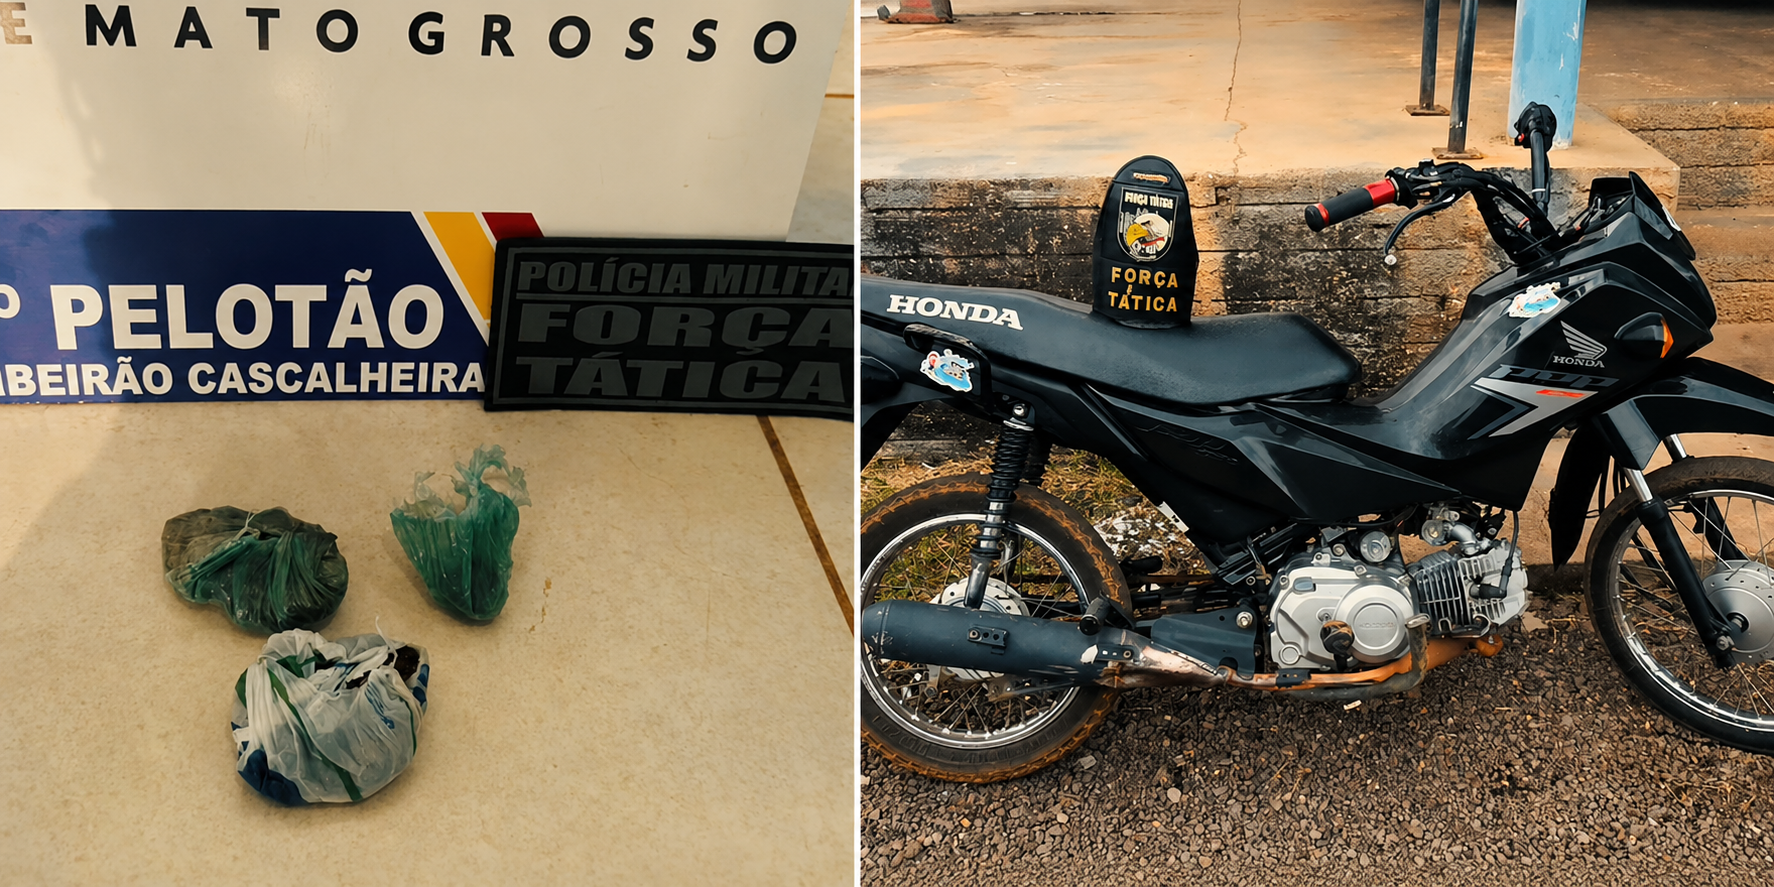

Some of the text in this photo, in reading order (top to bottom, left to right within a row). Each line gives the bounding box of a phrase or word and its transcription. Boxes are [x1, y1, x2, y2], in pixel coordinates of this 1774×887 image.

[85, 4, 359, 53] MATO
[408, 12, 797, 64] GROSSO
[517, 257, 854, 296] POLÍCIA MILITA
[1111, 266, 1179, 289] FORÇA
[50, 268, 444, 350] PELOTÃO
[517, 302, 854, 356] FORÇA
[886, 294, 1024, 331] HONDA
[0, 356, 485, 396] BEIRÃO CASCALHEIRA
[515, 351, 846, 403] TÁTICA
[1552, 355, 1606, 369] HONDA
